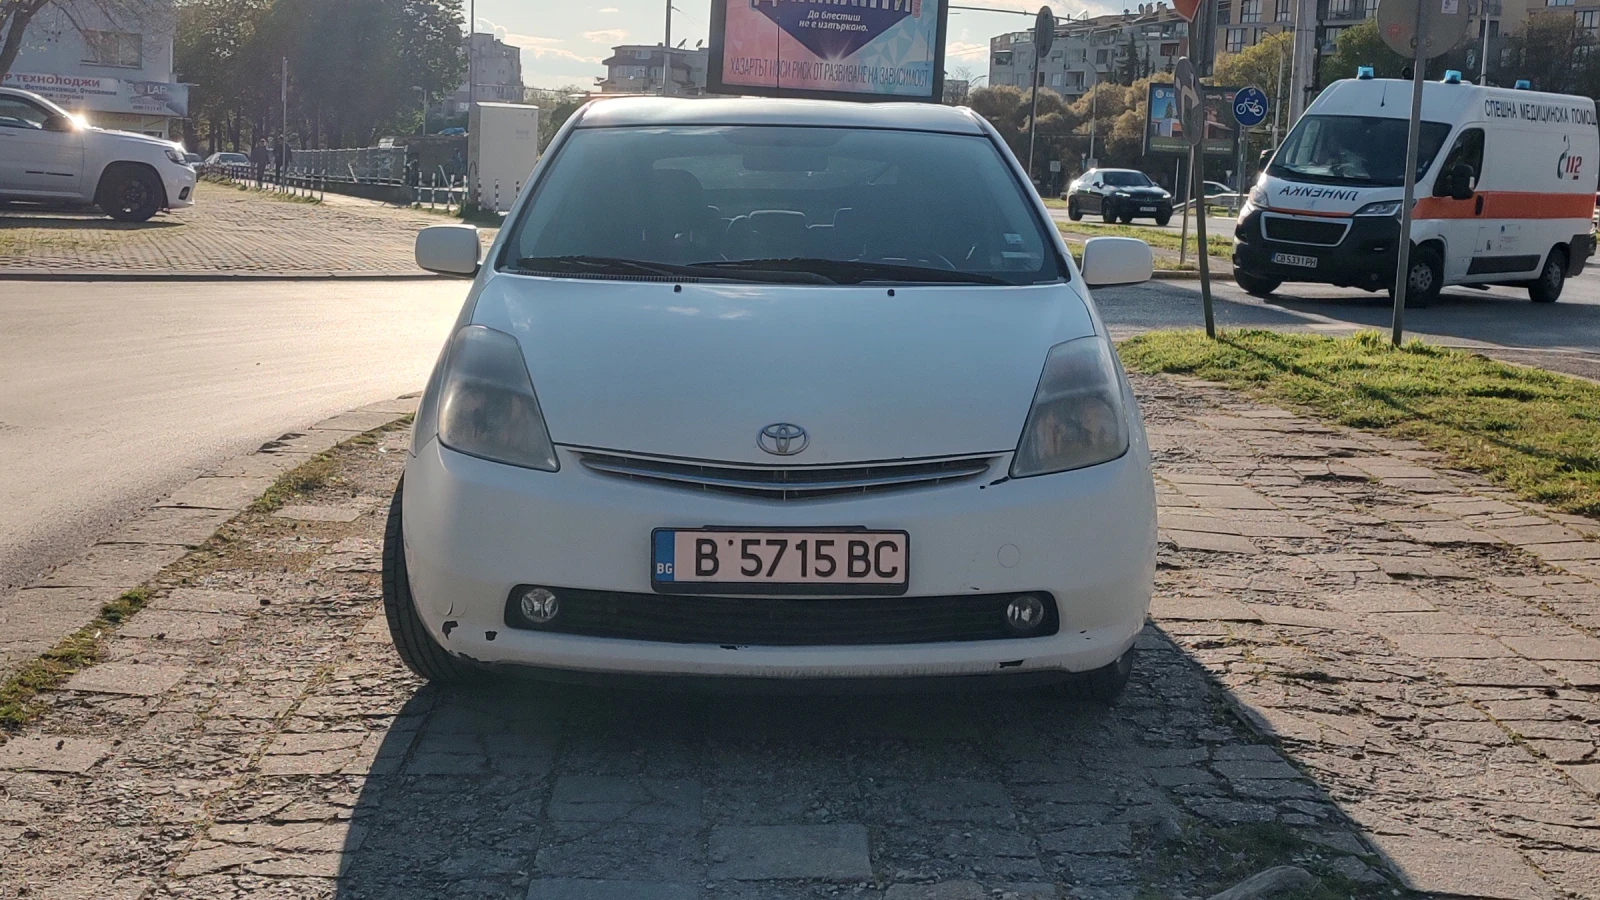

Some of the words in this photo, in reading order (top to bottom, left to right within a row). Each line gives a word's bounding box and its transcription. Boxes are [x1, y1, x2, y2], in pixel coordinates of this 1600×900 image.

[808, 10, 820, 19] До
[821, 11, 861, 22] блестиш
[799, 20, 810, 28] не
[818, 21, 868, 32] изтъркано.
[730, 57, 768, 77] ХАЗАРТЪТ
[769, 59, 791, 79] НОСИ
[792, 60, 813, 80] РИСК
[813, 62, 825, 81] ОТ
[824, 63, 867, 84] РАЗВИВАНЕ
[868, 65, 878, 83] НА
[880, 66, 929, 88] ЗАВИСИМОСТ
[15, 74, 100, 88] ТЕХНОЛОДЖИ
[1485, 100, 1517, 118] СПЕШНА
[1520, 103, 1569, 123] МЕДИЦИНСКА
[1565, 155, 1582, 174] 112
[740, 539, 837, 578] 5715
[847, 540, 899, 578] BC
[656, 562, 673, 575] BG
